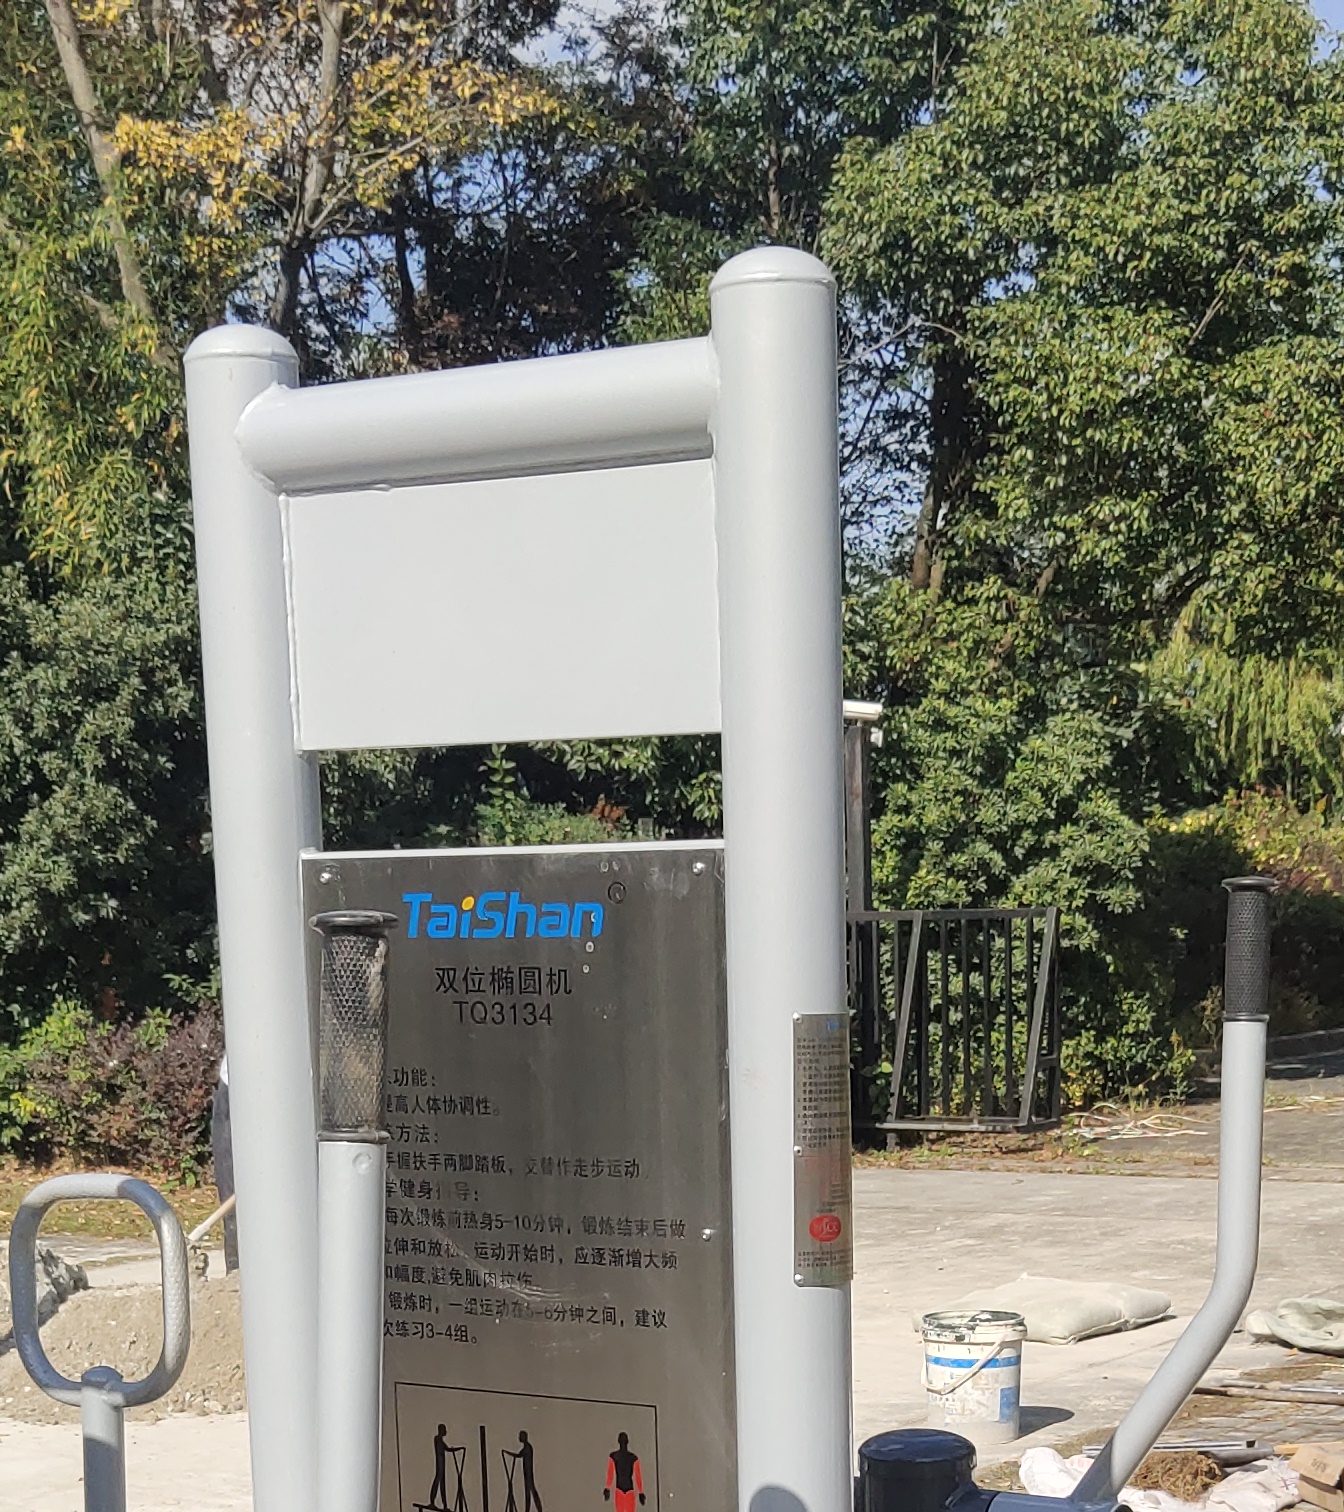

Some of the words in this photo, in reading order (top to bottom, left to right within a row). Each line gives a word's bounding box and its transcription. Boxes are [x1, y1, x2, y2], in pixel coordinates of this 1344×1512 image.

[402, 891, 605, 938] TaiShan
[435, 966, 572, 995] 双位椭圆机
[452, 1000, 554, 1026] TQ3134
[387, 1066, 436, 1087] 功能：
[386, 1178, 479, 1201] 学健身导：
[385, 1237, 678, 1269] 伸和放松运动开始时，应逐渐增大频
